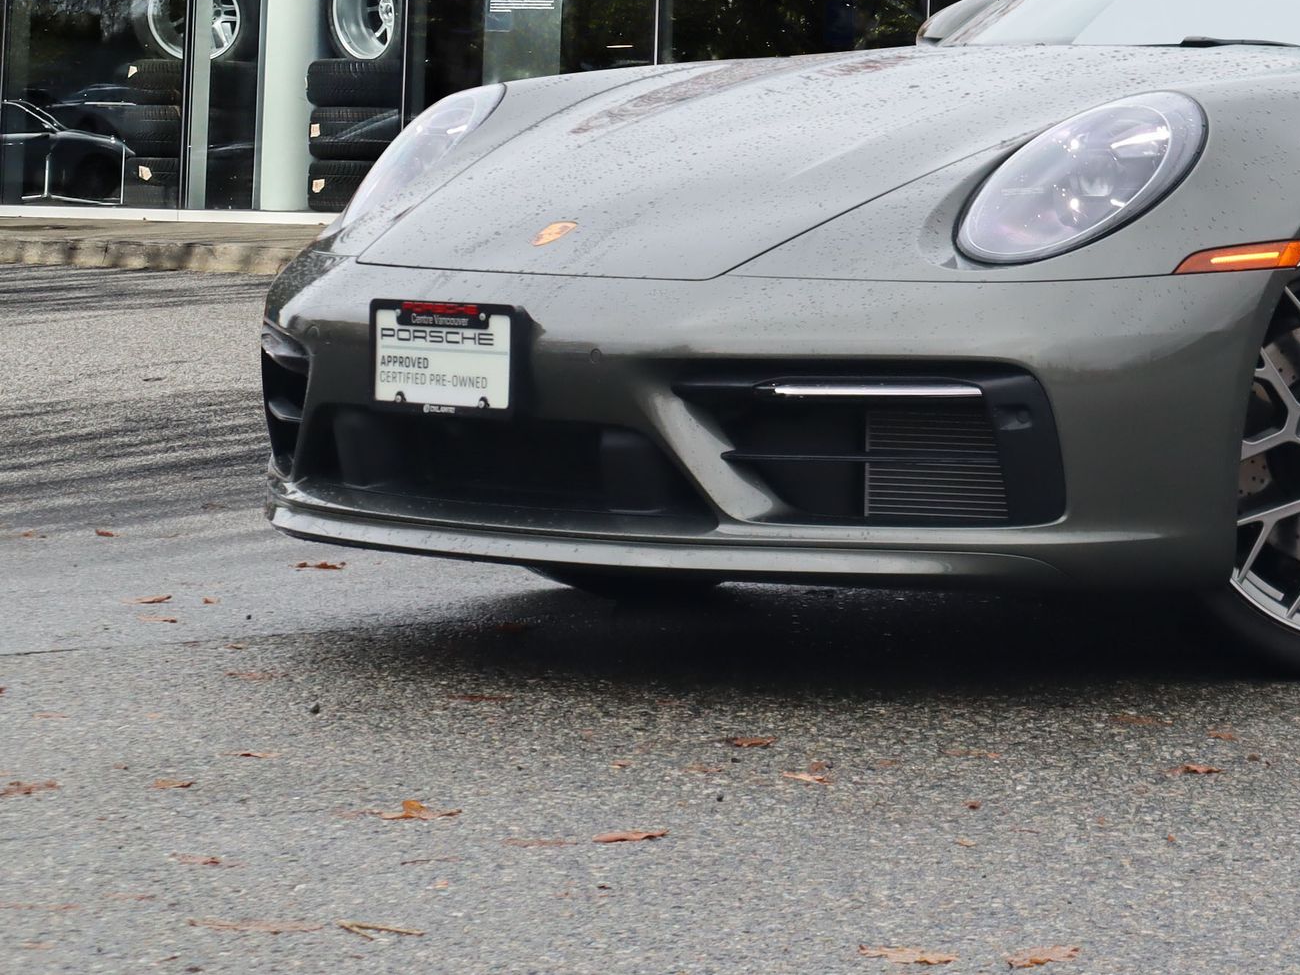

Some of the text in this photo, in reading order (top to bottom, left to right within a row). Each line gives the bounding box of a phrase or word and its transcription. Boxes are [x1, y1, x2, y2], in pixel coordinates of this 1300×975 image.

[380, 327, 494, 346] PORSCHE
[380, 355, 429, 369] APPROVED
[379, 370, 488, 390] CERTIFIED PRE-OWNED
